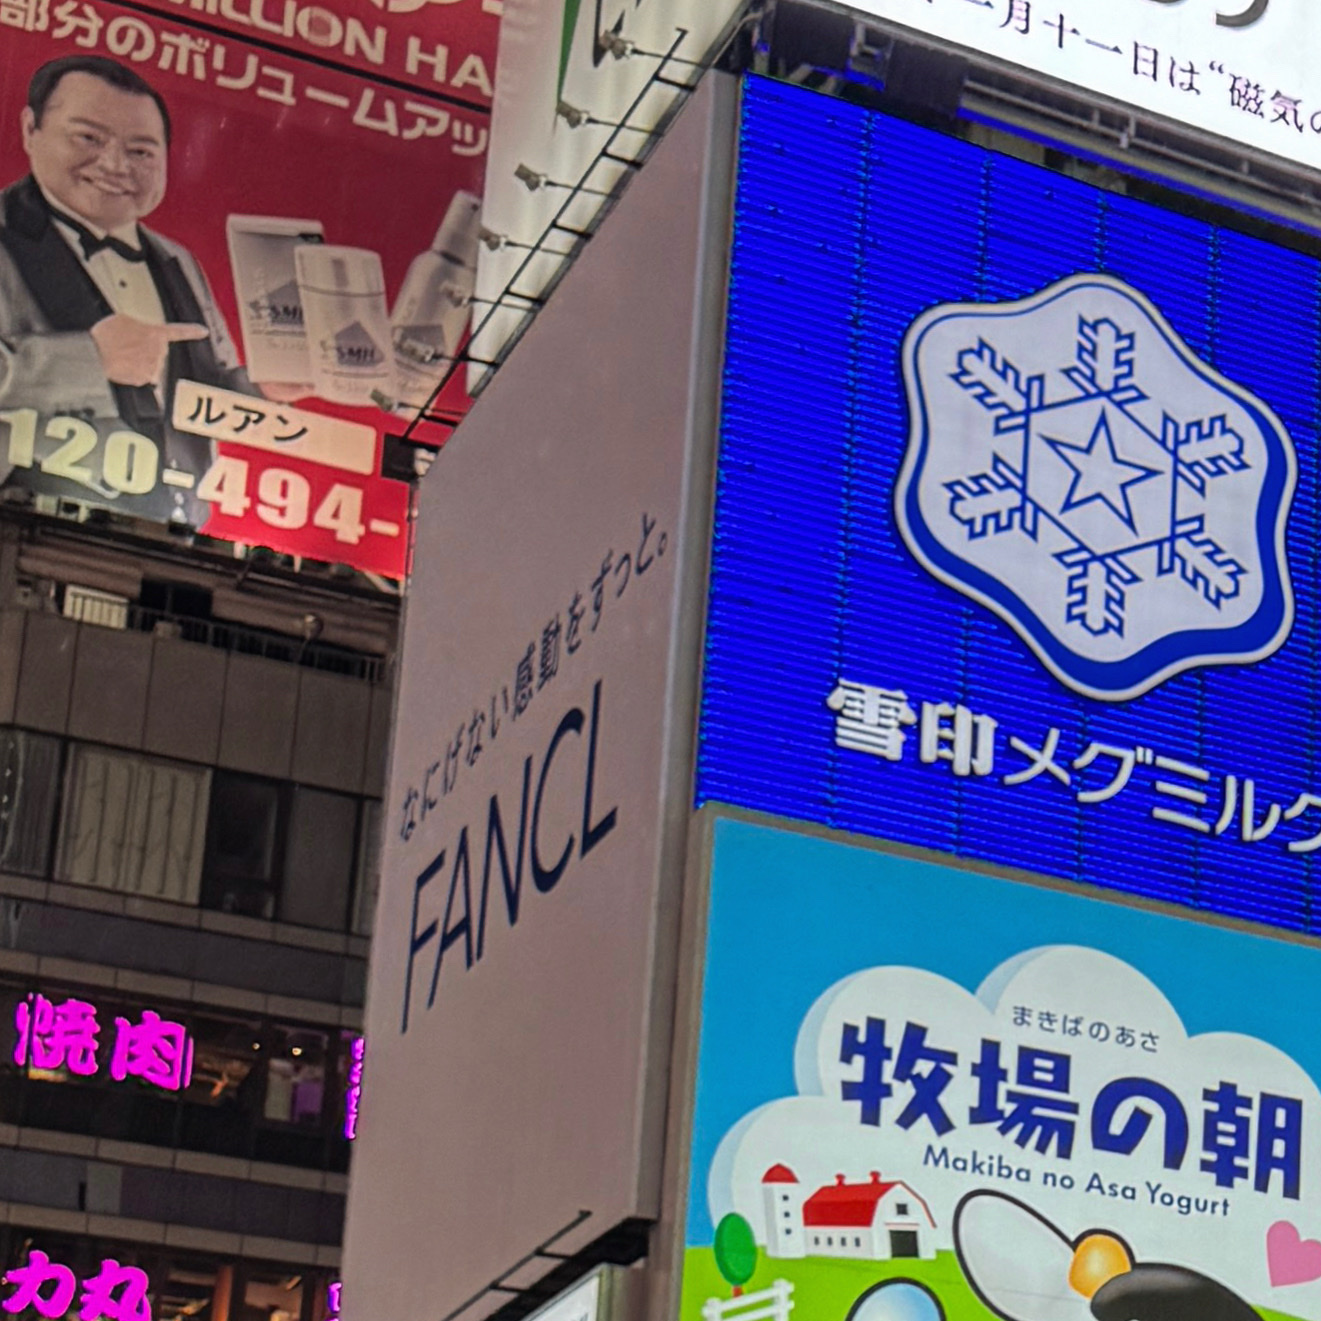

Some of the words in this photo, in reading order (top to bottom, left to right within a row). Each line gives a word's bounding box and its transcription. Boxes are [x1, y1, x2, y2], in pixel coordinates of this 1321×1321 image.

[190, 0, 388, 65] LLION
[188, 395, 309, 443] ルアン
[402, 679, 618, 1036] FANCL
[14, 993, 194, 1091] 焼肉
[1011, 1004, 1161, 1054] まきばのあさ
[839, 1016, 1303, 1200] 牧場の朝
[923, 1144, 1031, 1184] Makiba
[1042, 1164, 1076, 1191] no
[1084, 1172, 1138, 1202] Asa
[1144, 1182, 1231, 1219] Yogurt
